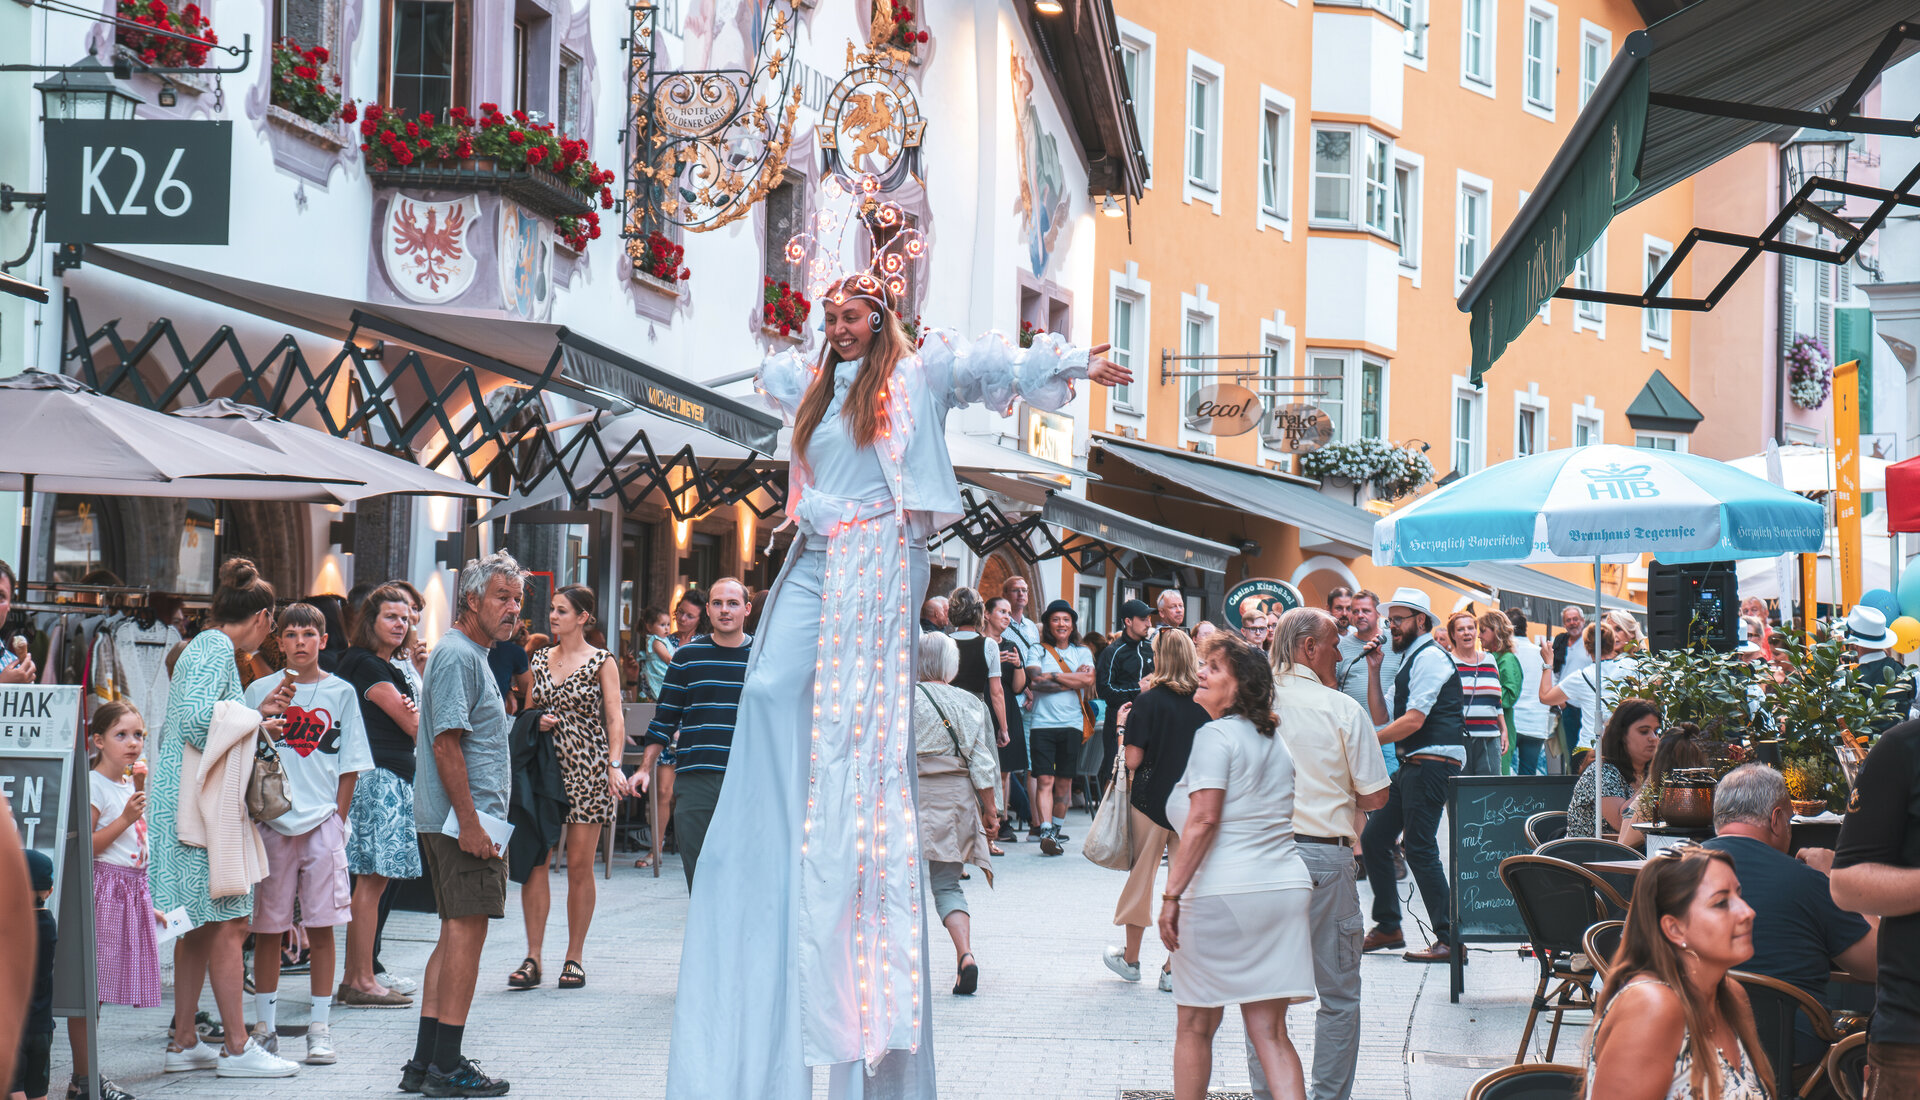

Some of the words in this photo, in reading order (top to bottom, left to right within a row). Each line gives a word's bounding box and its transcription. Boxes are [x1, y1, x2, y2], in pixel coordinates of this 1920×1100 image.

[664, 106, 704, 128] GOLDENER
[703, 106, 727, 126] GREIF
[681, 107, 709, 116] HOTEL
[81, 146, 193, 217] K26
[1196, 398, 1252, 418] ecco!
[1274, 414, 1317, 429] Take
[1586, 478, 1661, 500] HTB
[1568, 528, 1631, 543] Brauhaus
[1228, 585, 1255, 606] Casino
[0, 691, 54, 718] HAK
[1462, 827, 1484, 848] mit
